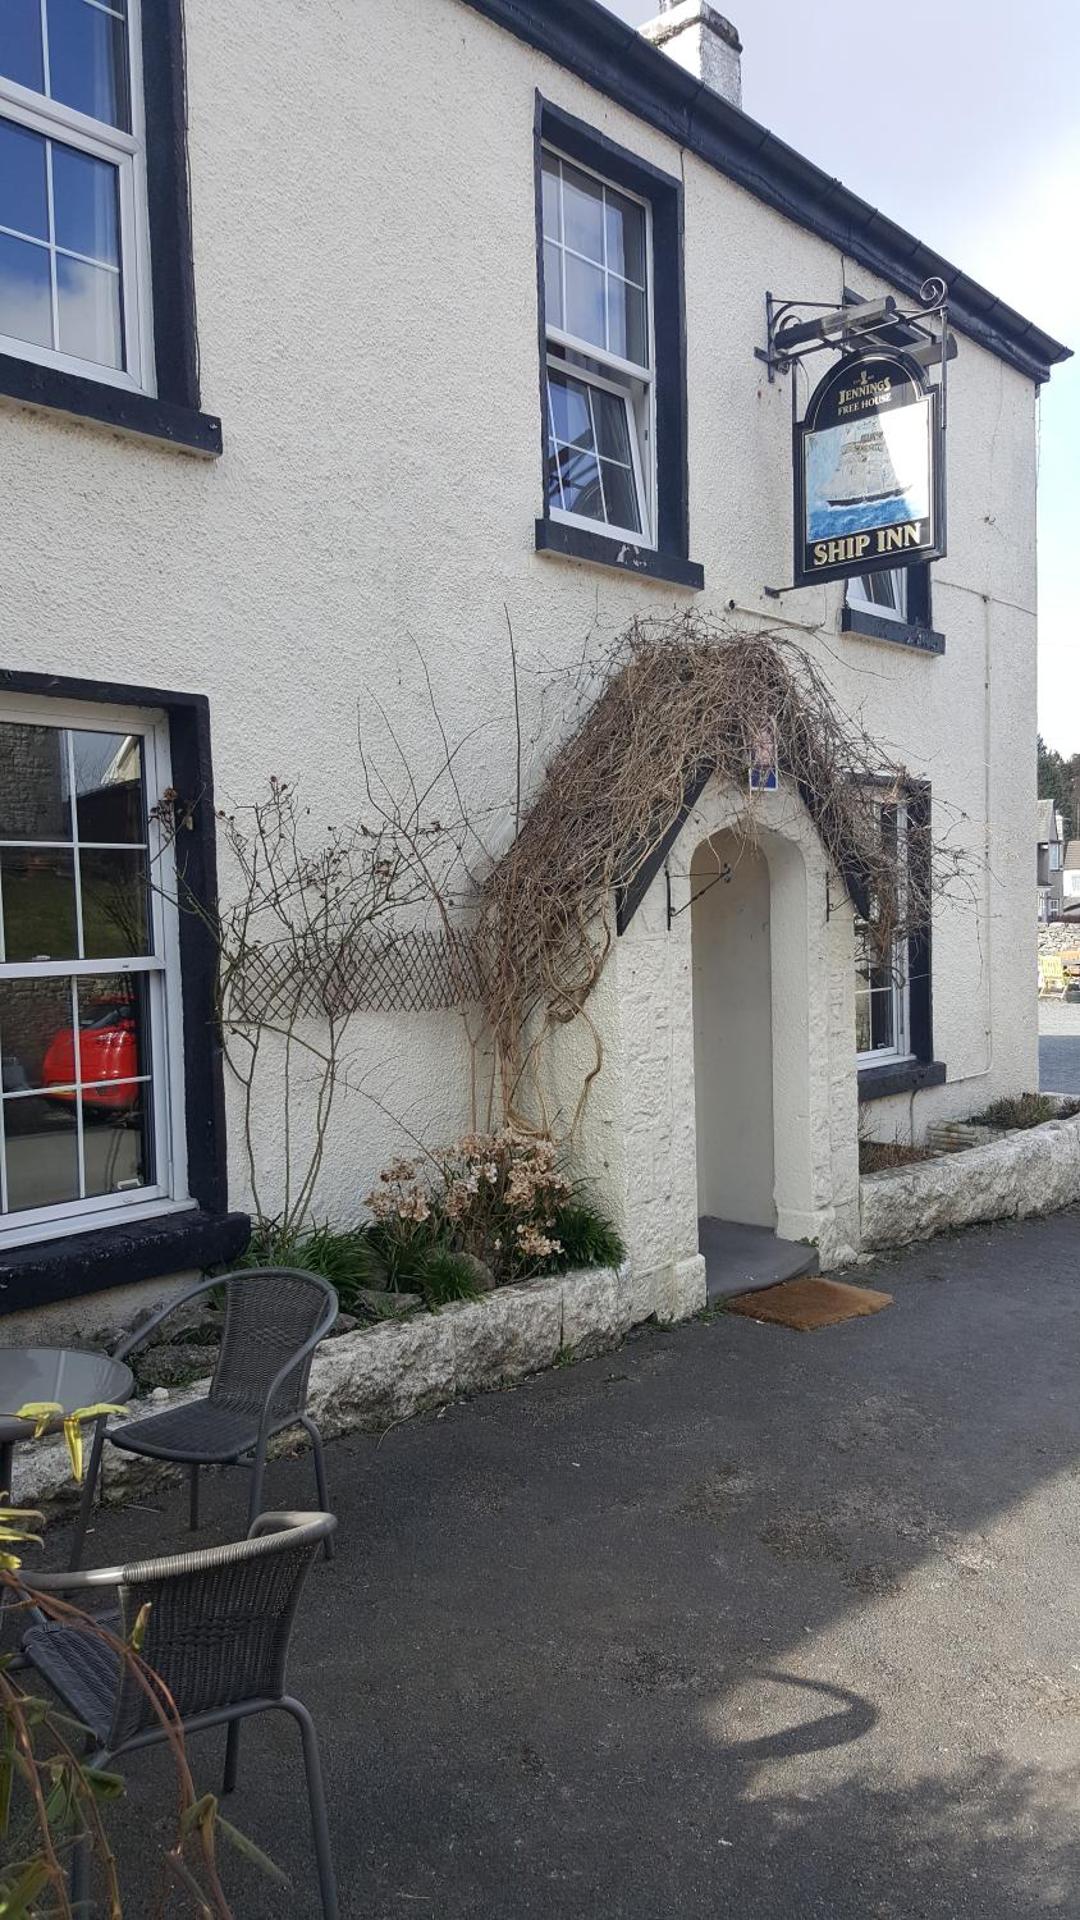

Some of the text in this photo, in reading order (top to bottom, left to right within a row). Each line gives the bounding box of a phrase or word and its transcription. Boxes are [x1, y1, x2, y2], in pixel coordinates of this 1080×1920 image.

[837, 393, 891, 416] FREE HOUSE
[838, 377, 891, 405] JENNINGS
[814, 522, 921, 565] SHIP INN
